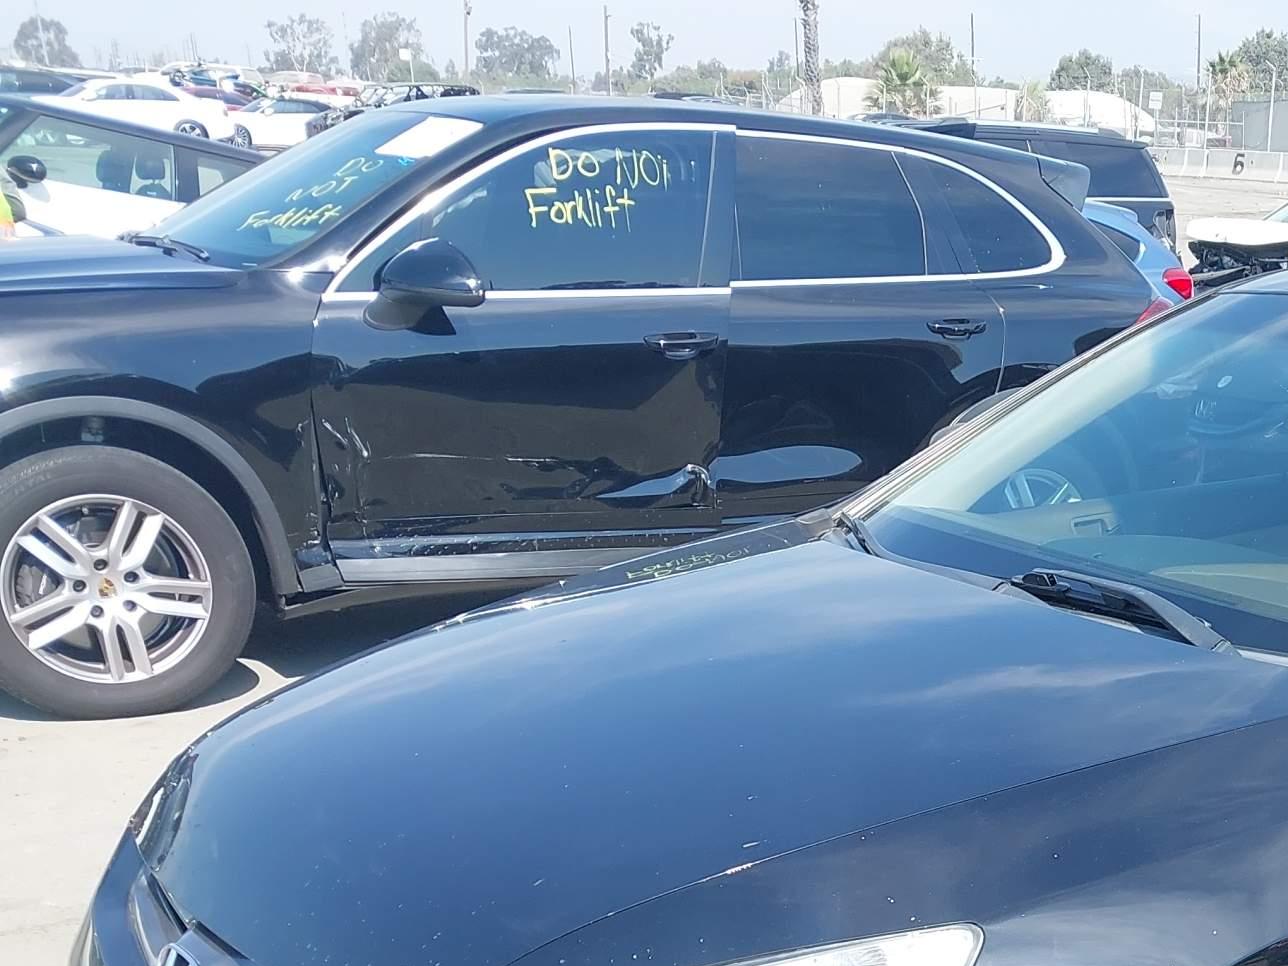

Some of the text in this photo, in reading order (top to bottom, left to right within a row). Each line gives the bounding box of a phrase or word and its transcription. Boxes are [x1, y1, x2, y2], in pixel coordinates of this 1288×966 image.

[335, 157, 384, 177] DO
[548, 147, 600, 181] DO
[285, 176, 358, 203] NOT
[524, 186, 635, 229] Forklift
